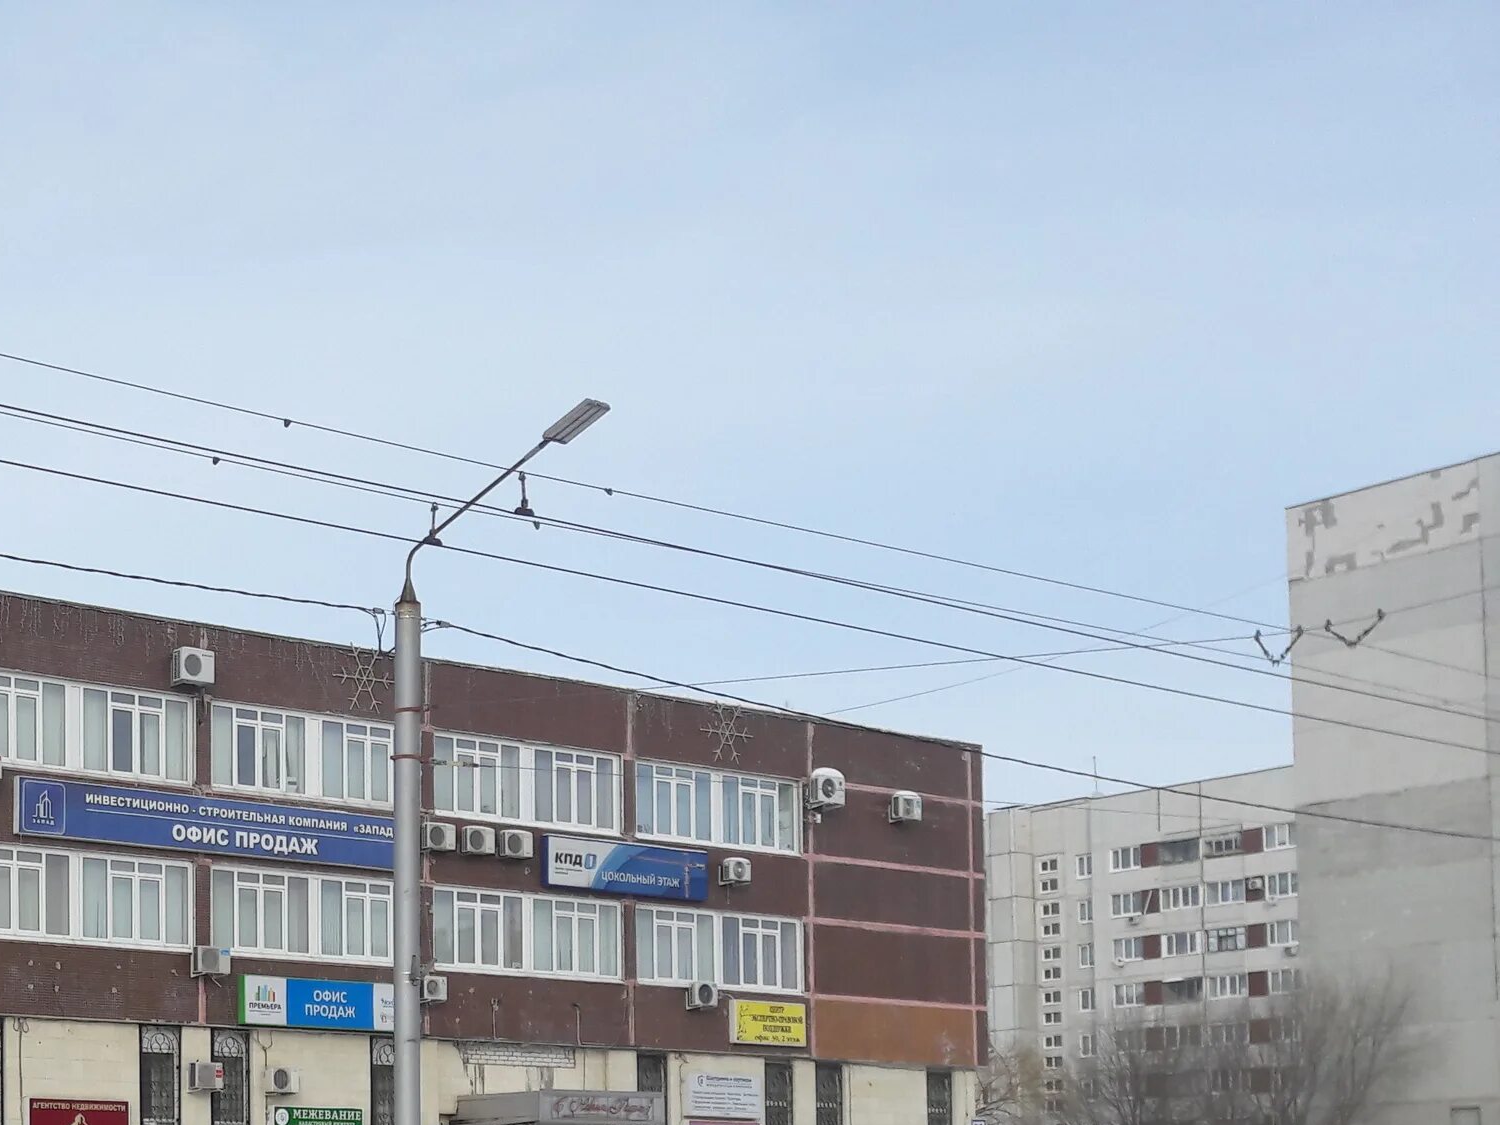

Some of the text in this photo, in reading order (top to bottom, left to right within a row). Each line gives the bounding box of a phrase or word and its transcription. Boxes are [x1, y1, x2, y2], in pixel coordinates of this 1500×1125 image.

[85, 793, 189, 814] ИНВЕСТИЦИОННО
[198, 806, 286, 825] СТРОИТЕЛЬНАЯ
[288, 816, 348, 832] КОМПАНИЯ
[32, 818, 56, 826] ЗАПАД
[172, 824, 319, 855] ОФИС ПРОДАЖ
[555, 852, 583, 867] КПД
[602, 871, 681, 888] ЦОКОЛЬНЫЙ ЭТАЖ
[313, 990, 348, 1004] ОФИС
[248, 1002, 282, 1010] ПРЕМЬЕРА
[305, 1004, 356, 1020] ПРОДАЖ
[32, 1102, 127, 1112] АГЕНТСТВО НЕДВИЖИМОСТИ
[292, 1108, 362, 1121] МЕЖЕВАНИЕ
